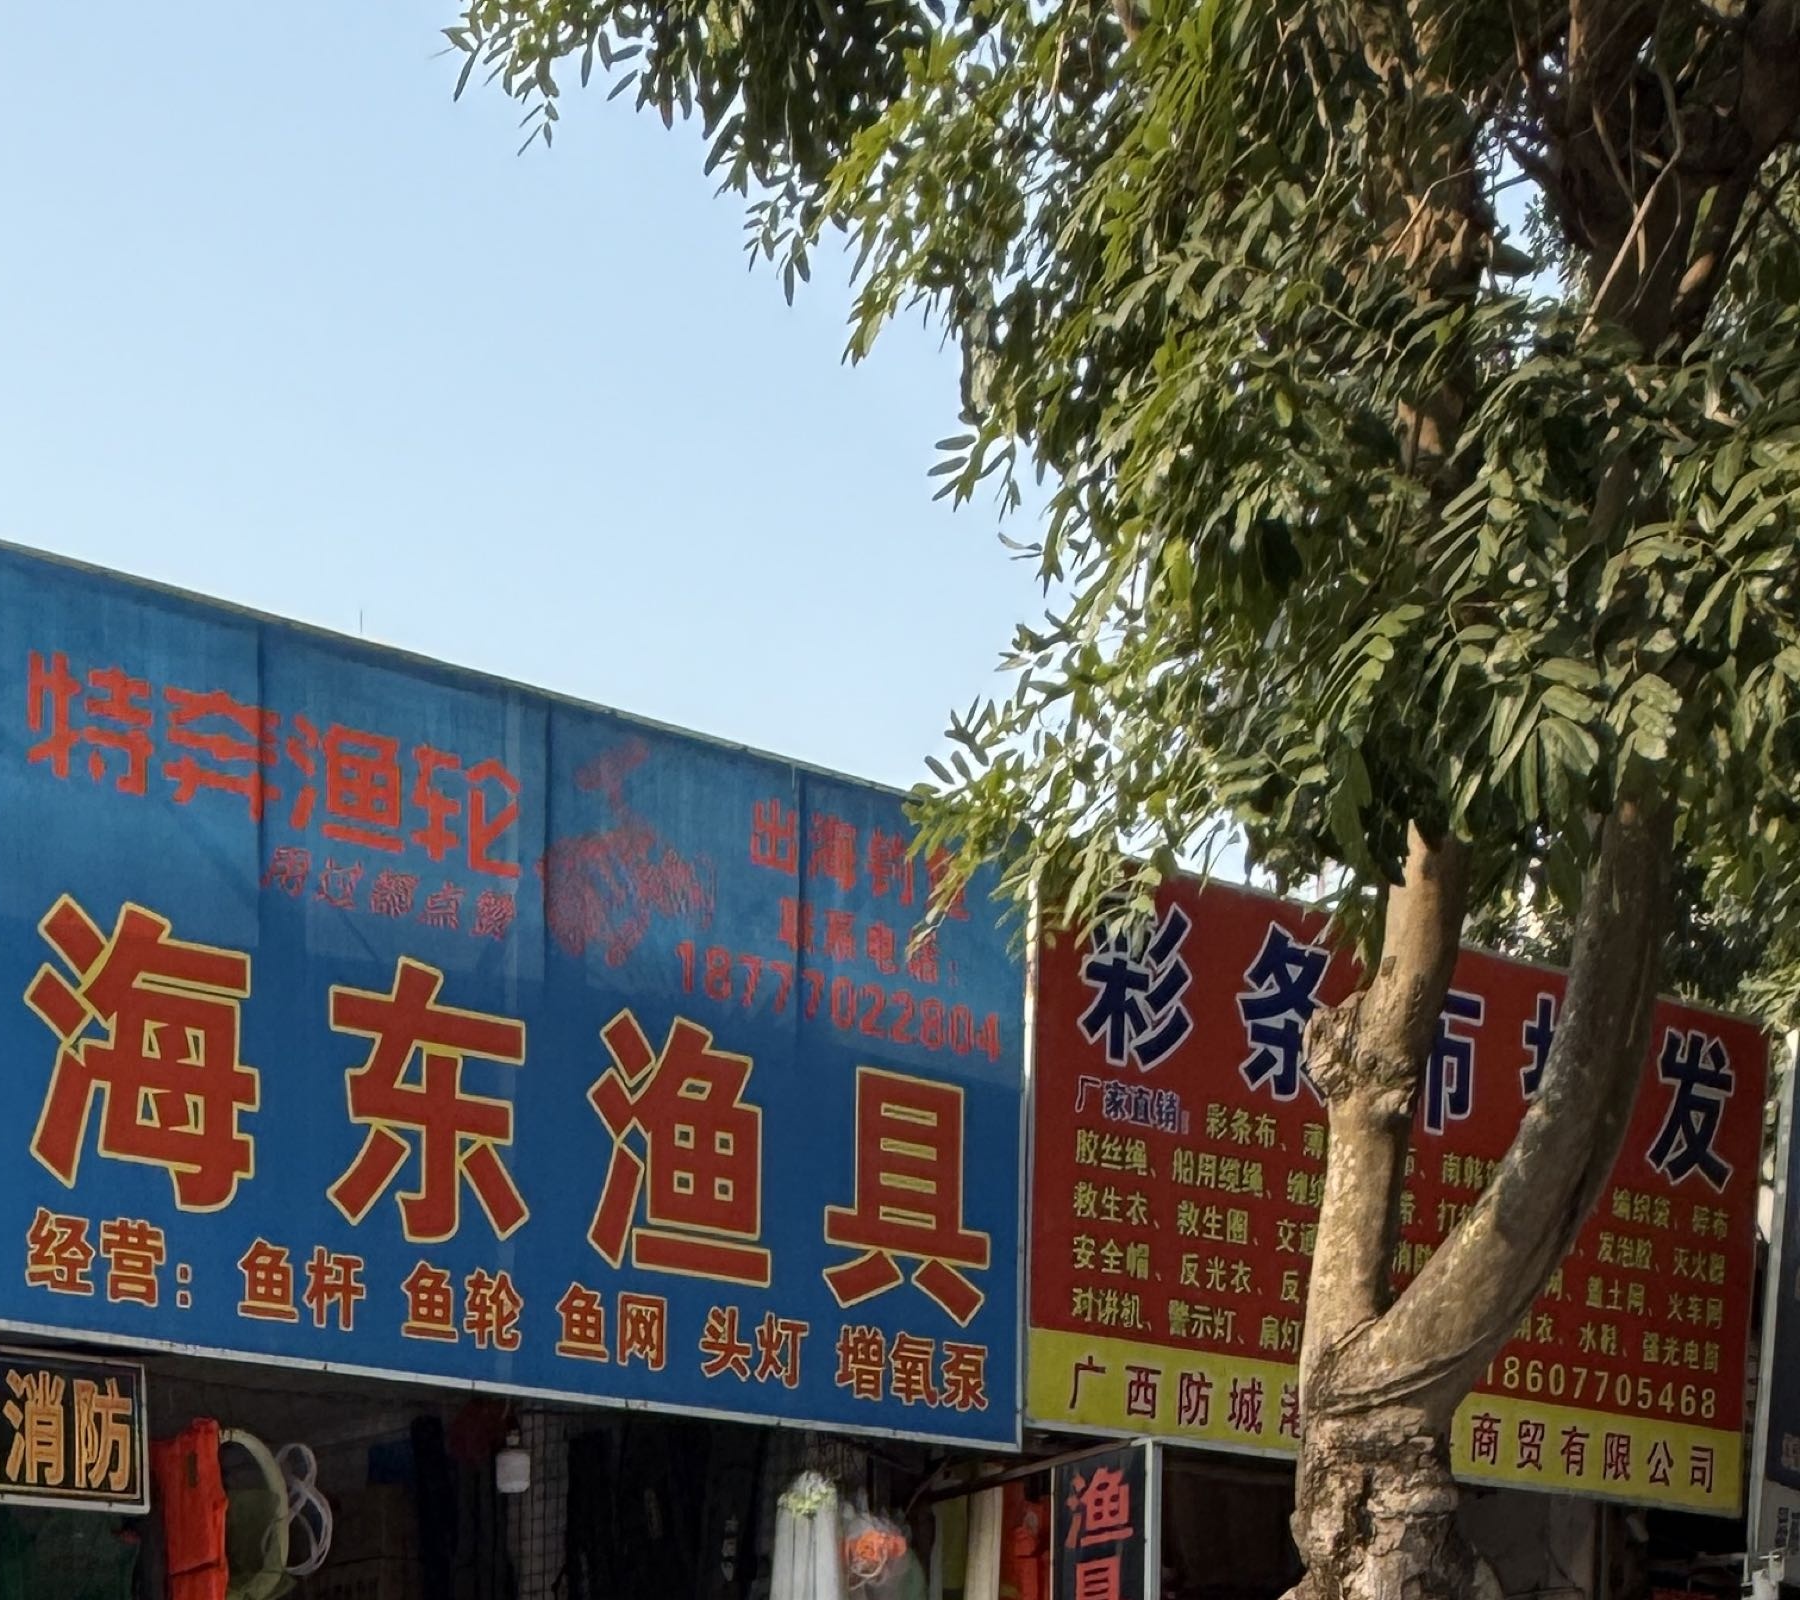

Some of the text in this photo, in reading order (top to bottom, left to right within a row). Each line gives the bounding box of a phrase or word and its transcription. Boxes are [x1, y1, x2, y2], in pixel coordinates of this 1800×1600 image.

[674, 939, 1001, 1063] 18777022804
[23, 893, 991, 1328] 海东渔具
[237, 1237, 366, 1331] 鱼杆
[401, 1259, 523, 1351] 鱼轮
[555, 1281, 668, 1372] 鱼网
[699, 1306, 810, 1389] 头灯
[835, 1324, 989, 1412] 增氧泵
[1485, 1355, 1717, 1419] 18607705468
